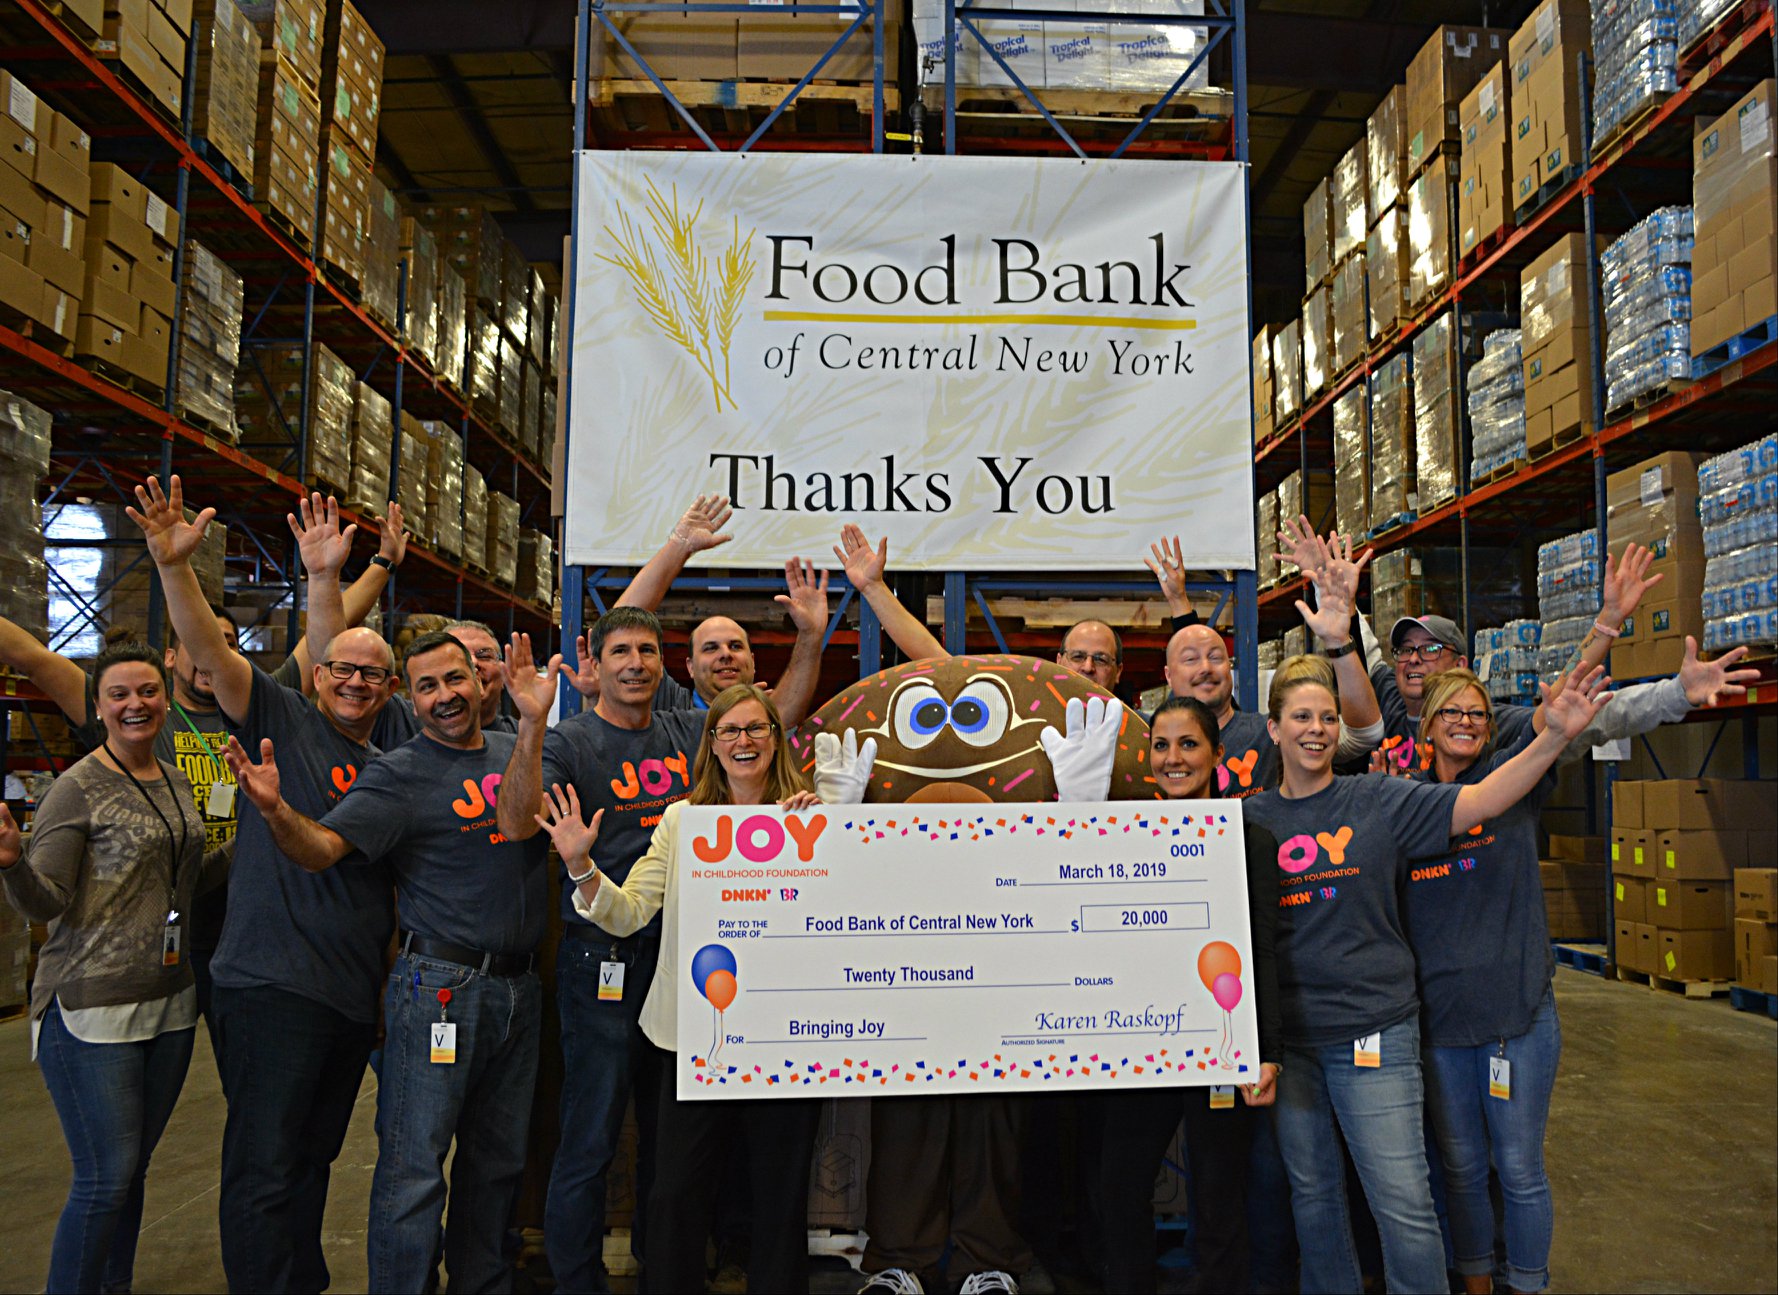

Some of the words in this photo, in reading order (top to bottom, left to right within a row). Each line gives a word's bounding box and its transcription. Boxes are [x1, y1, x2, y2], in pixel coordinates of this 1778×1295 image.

[1050, 36, 1090, 54] Tropical
[1056, 47, 1094, 62] Delight
[765, 234, 960, 305] Food
[991, 232, 1195, 307] Bank
[764, 333, 804, 378] of
[820, 334, 977, 370] Central
[996, 337, 1088, 373] New
[1108, 340, 1193, 375] York
[709, 453, 951, 514] Thanks
[977, 457, 1115, 514] You
[610, 751, 690, 799] JOY
[452, 773, 504, 818] JO
[624, 800, 664, 811] CHILDHOOD
[693, 814, 827, 863] JOY
[1171, 844, 1204, 857] 0001
[1278, 826, 1354, 873] OY
[704, 870, 763, 878] CHILDHOOD
[766, 869, 828, 877] FOUNDATION
[1060, 864, 1103, 879] March
[1109, 864, 1128, 880] 18,
[1134, 863, 1166, 877] 2019
[1304, 867, 1360, 882] FOUNDATION
[781, 888, 798, 901] BR
[806, 917, 843, 931] Food
[849, 916, 885, 930] Bank
[890, 916, 905, 930] of
[909, 915, 960, 929] Central
[966, 915, 997, 928] New
[1001, 914, 1033, 928] York
[1071, 920, 1079, 932] $
[1122, 910, 1168, 926] 20,000
[718, 930, 747, 938] ORDER
[750, 930, 760, 938] OF
[844, 968, 895, 985] Twenty
[900, 966, 973, 981] Thousand
[790, 1020, 853, 1038] Bringing
[858, 1019, 884, 1037] Joy
[1035, 1012, 1097, 1030] Karen
[1104, 1004, 1186, 1036] Raskopf
